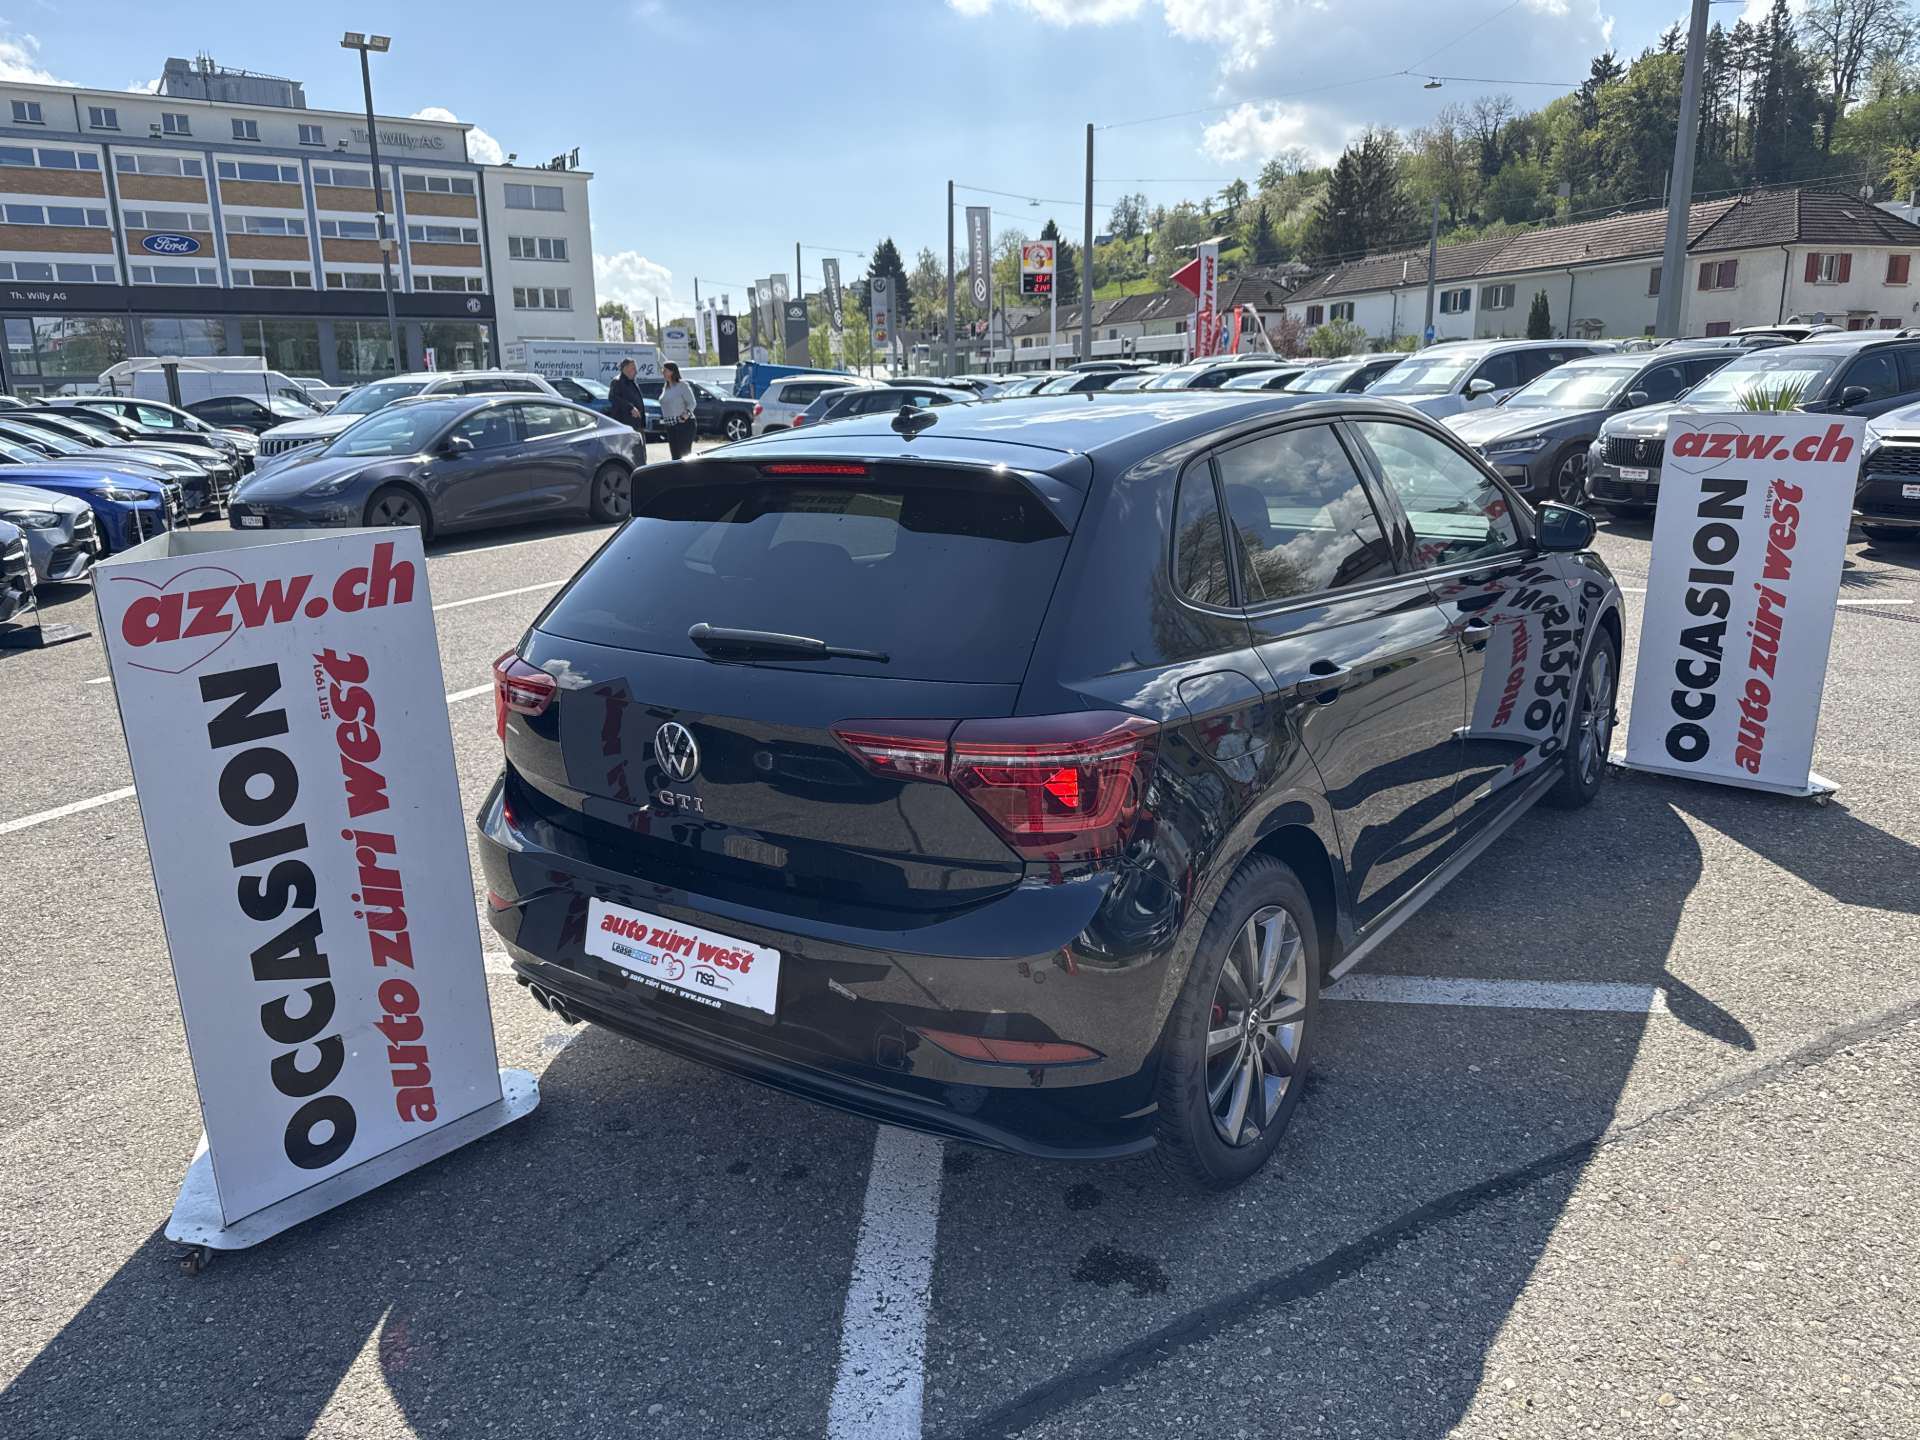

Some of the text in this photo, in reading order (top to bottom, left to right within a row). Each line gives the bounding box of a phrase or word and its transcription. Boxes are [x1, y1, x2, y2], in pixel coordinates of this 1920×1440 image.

[153, 235, 190, 252] Ford
[10, 291, 67, 303] Th. Willy AG
[720, 319, 736, 336] MG
[534, 361, 583, 370] Kurierdienst
[1672, 424, 1854, 463] azw.ch
[1763, 503, 1771, 519] SEIT
[122, 542, 415, 647] azw.ch
[1665, 478, 1748, 763] OCCASION
[1735, 478, 1804, 775] auto züri west
[313, 663, 331, 720] SEIT 1991
[658, 789, 704, 813] GTI
[315, 647, 438, 1123] auto züri west
[198, 662, 357, 1170] OCCASION
[600, 914, 754, 974] auto züri west
[695, 969, 715, 986] nsa
